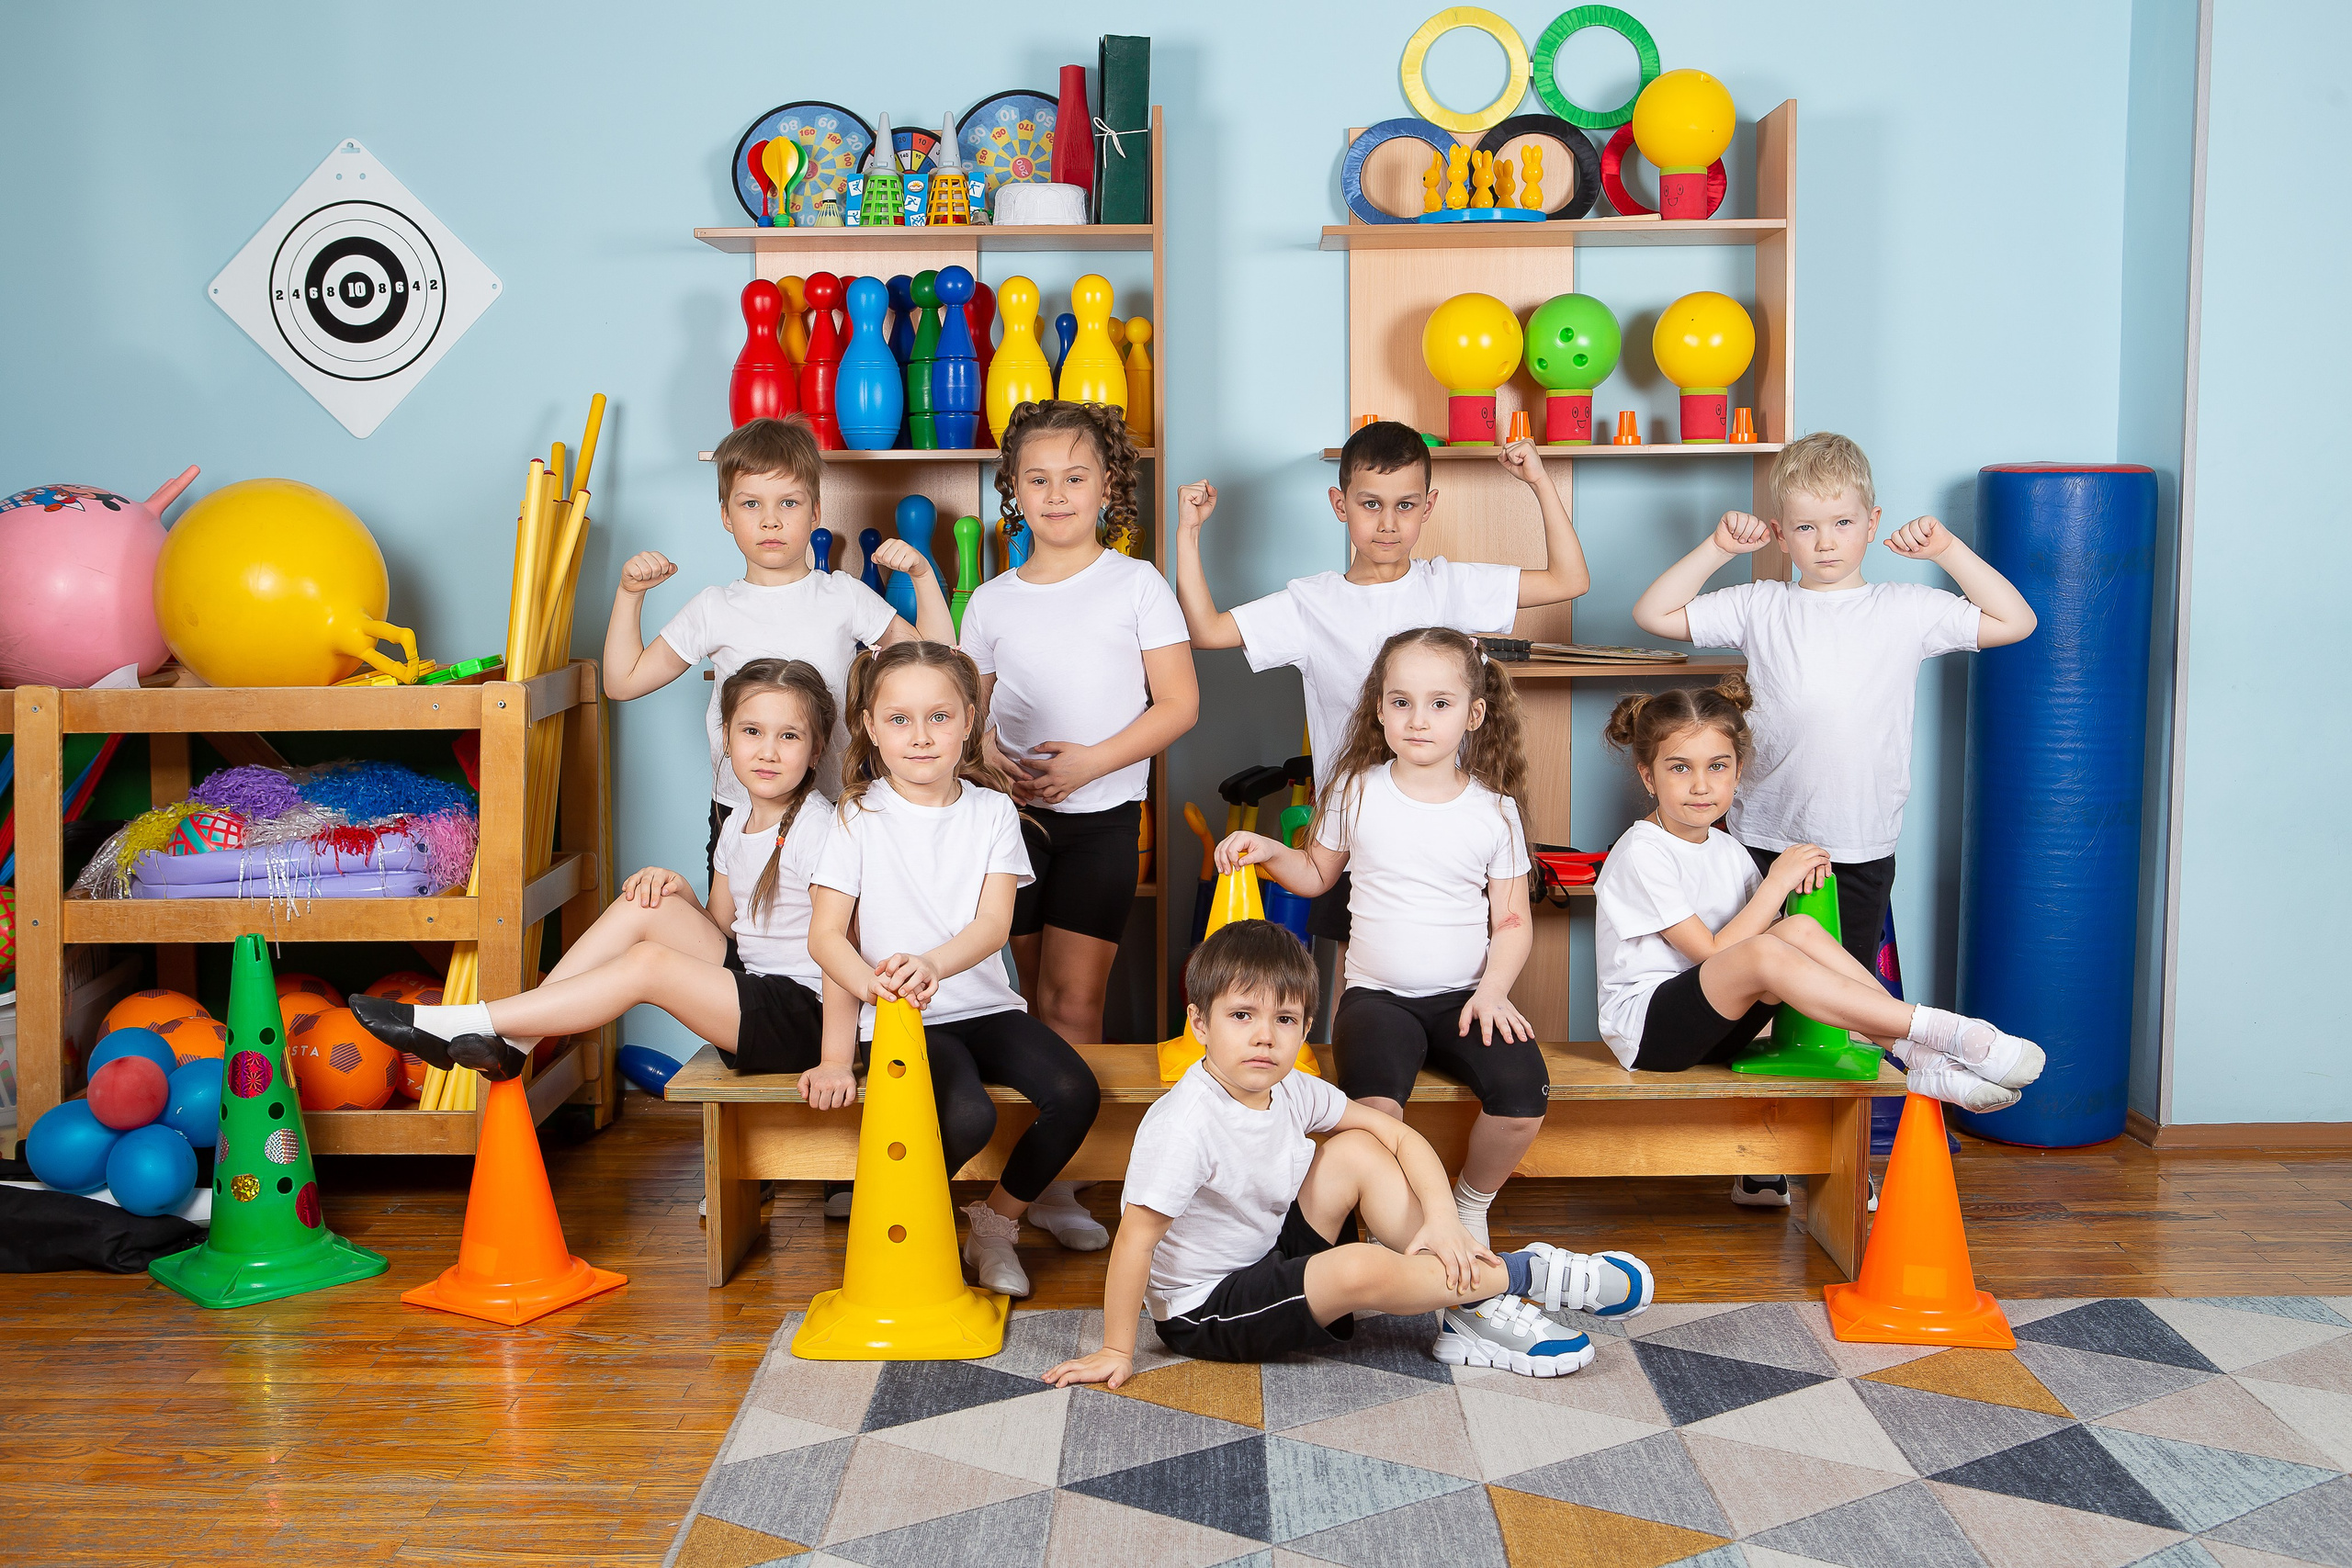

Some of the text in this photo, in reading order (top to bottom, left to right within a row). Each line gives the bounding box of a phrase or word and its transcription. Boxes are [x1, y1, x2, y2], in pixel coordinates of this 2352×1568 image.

[779, 119, 798, 133] 80
[818, 117, 837, 130] 60
[1035, 110, 1055, 128] 50
[799, 129, 816, 137] 160
[1018, 122, 1035, 131] 170
[827, 133, 842, 145] 180
[991, 128, 1006, 141] 130
[845, 134, 864, 152] 20
[843, 152, 853, 167] 100
[978, 149, 989, 164] 150
[1016, 159, 1029, 176] 200
[799, 215, 815, 225] 10
[276, 279, 438, 300] 2 4 6 8 10 8 6 4 2
